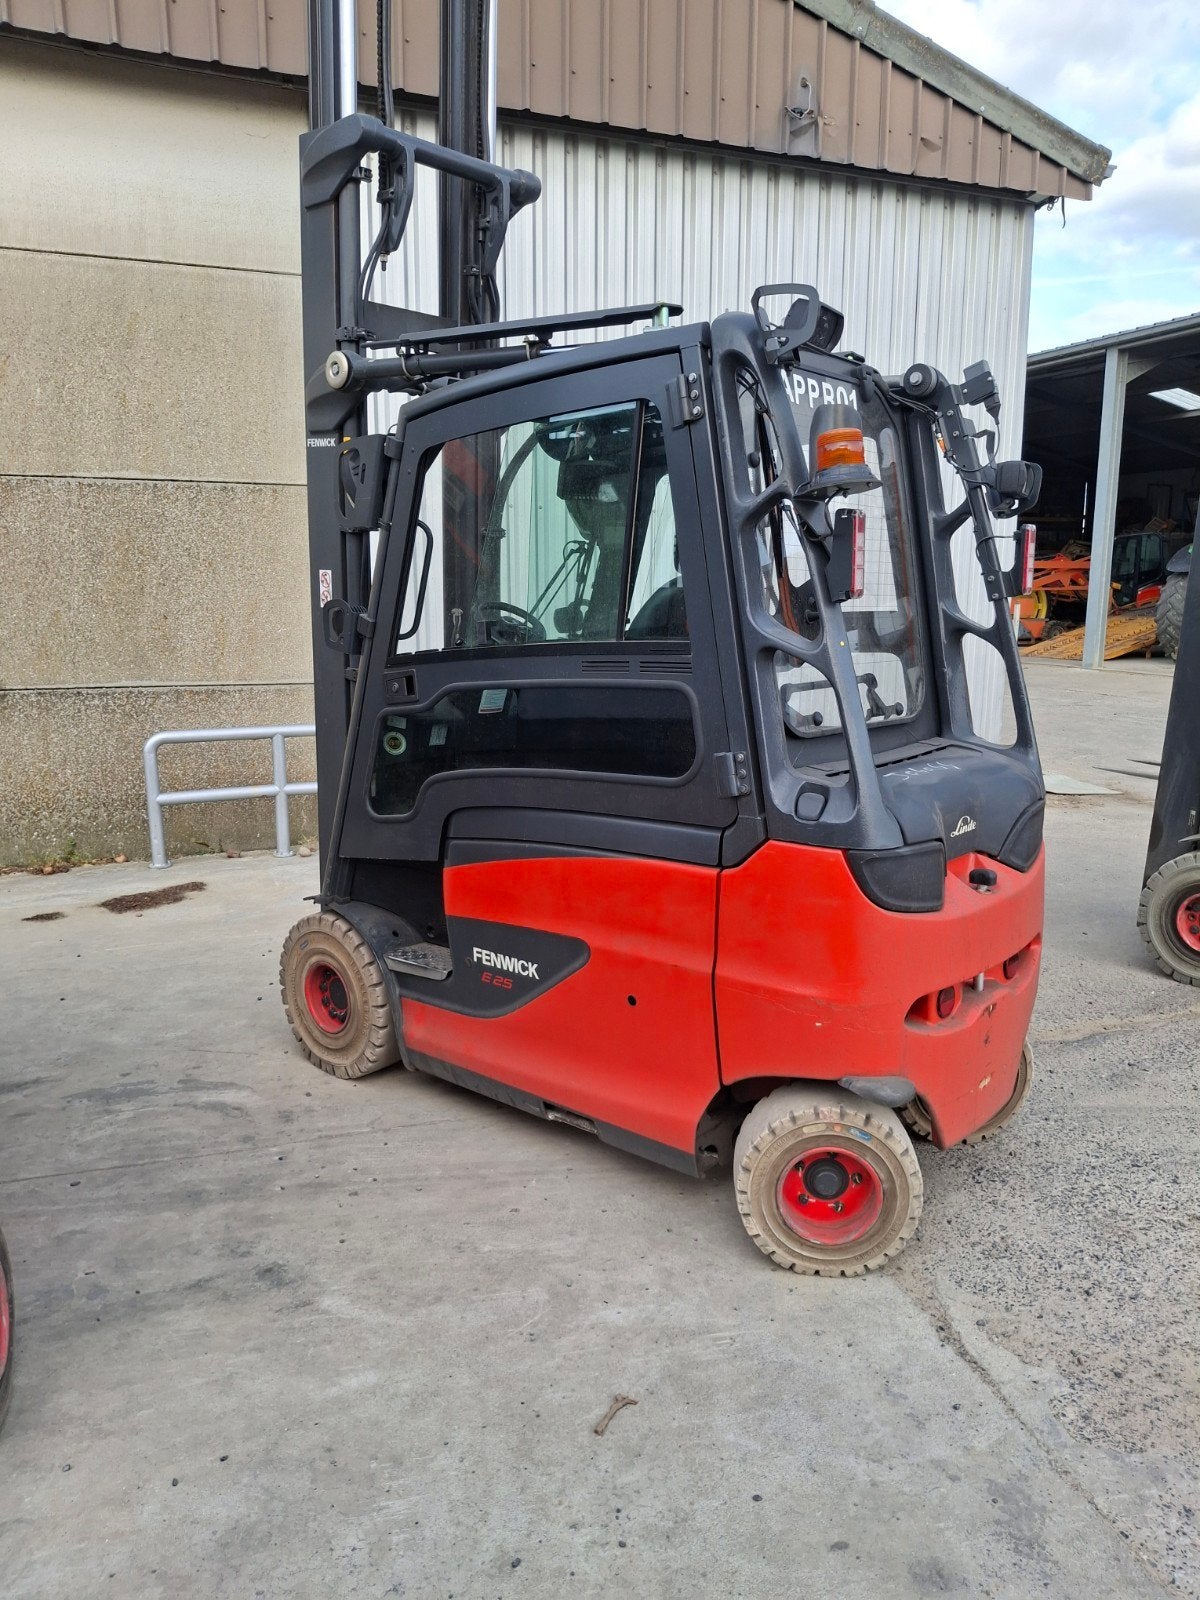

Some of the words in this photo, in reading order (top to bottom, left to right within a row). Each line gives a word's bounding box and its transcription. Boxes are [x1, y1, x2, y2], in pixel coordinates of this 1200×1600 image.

[307, 437, 336, 447] FENWICK
[950, 815, 977, 838] Linde
[472, 946, 540, 980] FENWICK
[481, 971, 492, 984] E
[493, 975, 513, 991] 25
